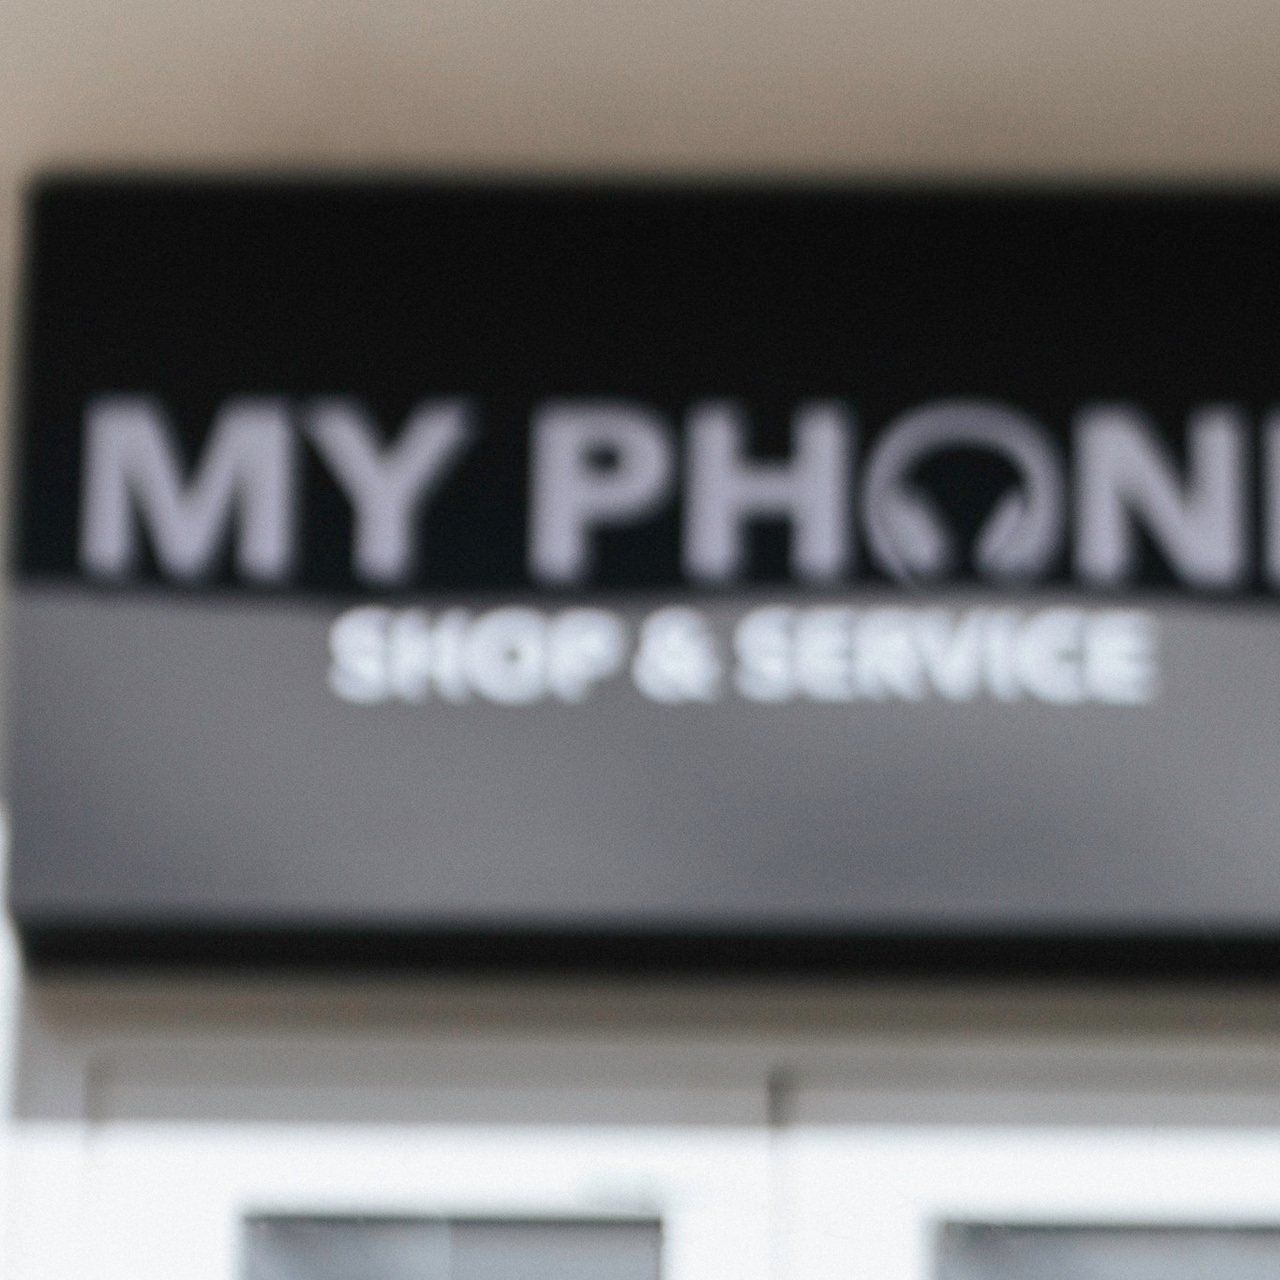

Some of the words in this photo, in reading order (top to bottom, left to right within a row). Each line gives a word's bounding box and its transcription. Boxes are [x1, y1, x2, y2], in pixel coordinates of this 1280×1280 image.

[80, 398, 472, 582] MY
[328, 604, 626, 706] SHOP
[631, 604, 722, 706] &
[732, 604, 1158, 708] SERVICE
